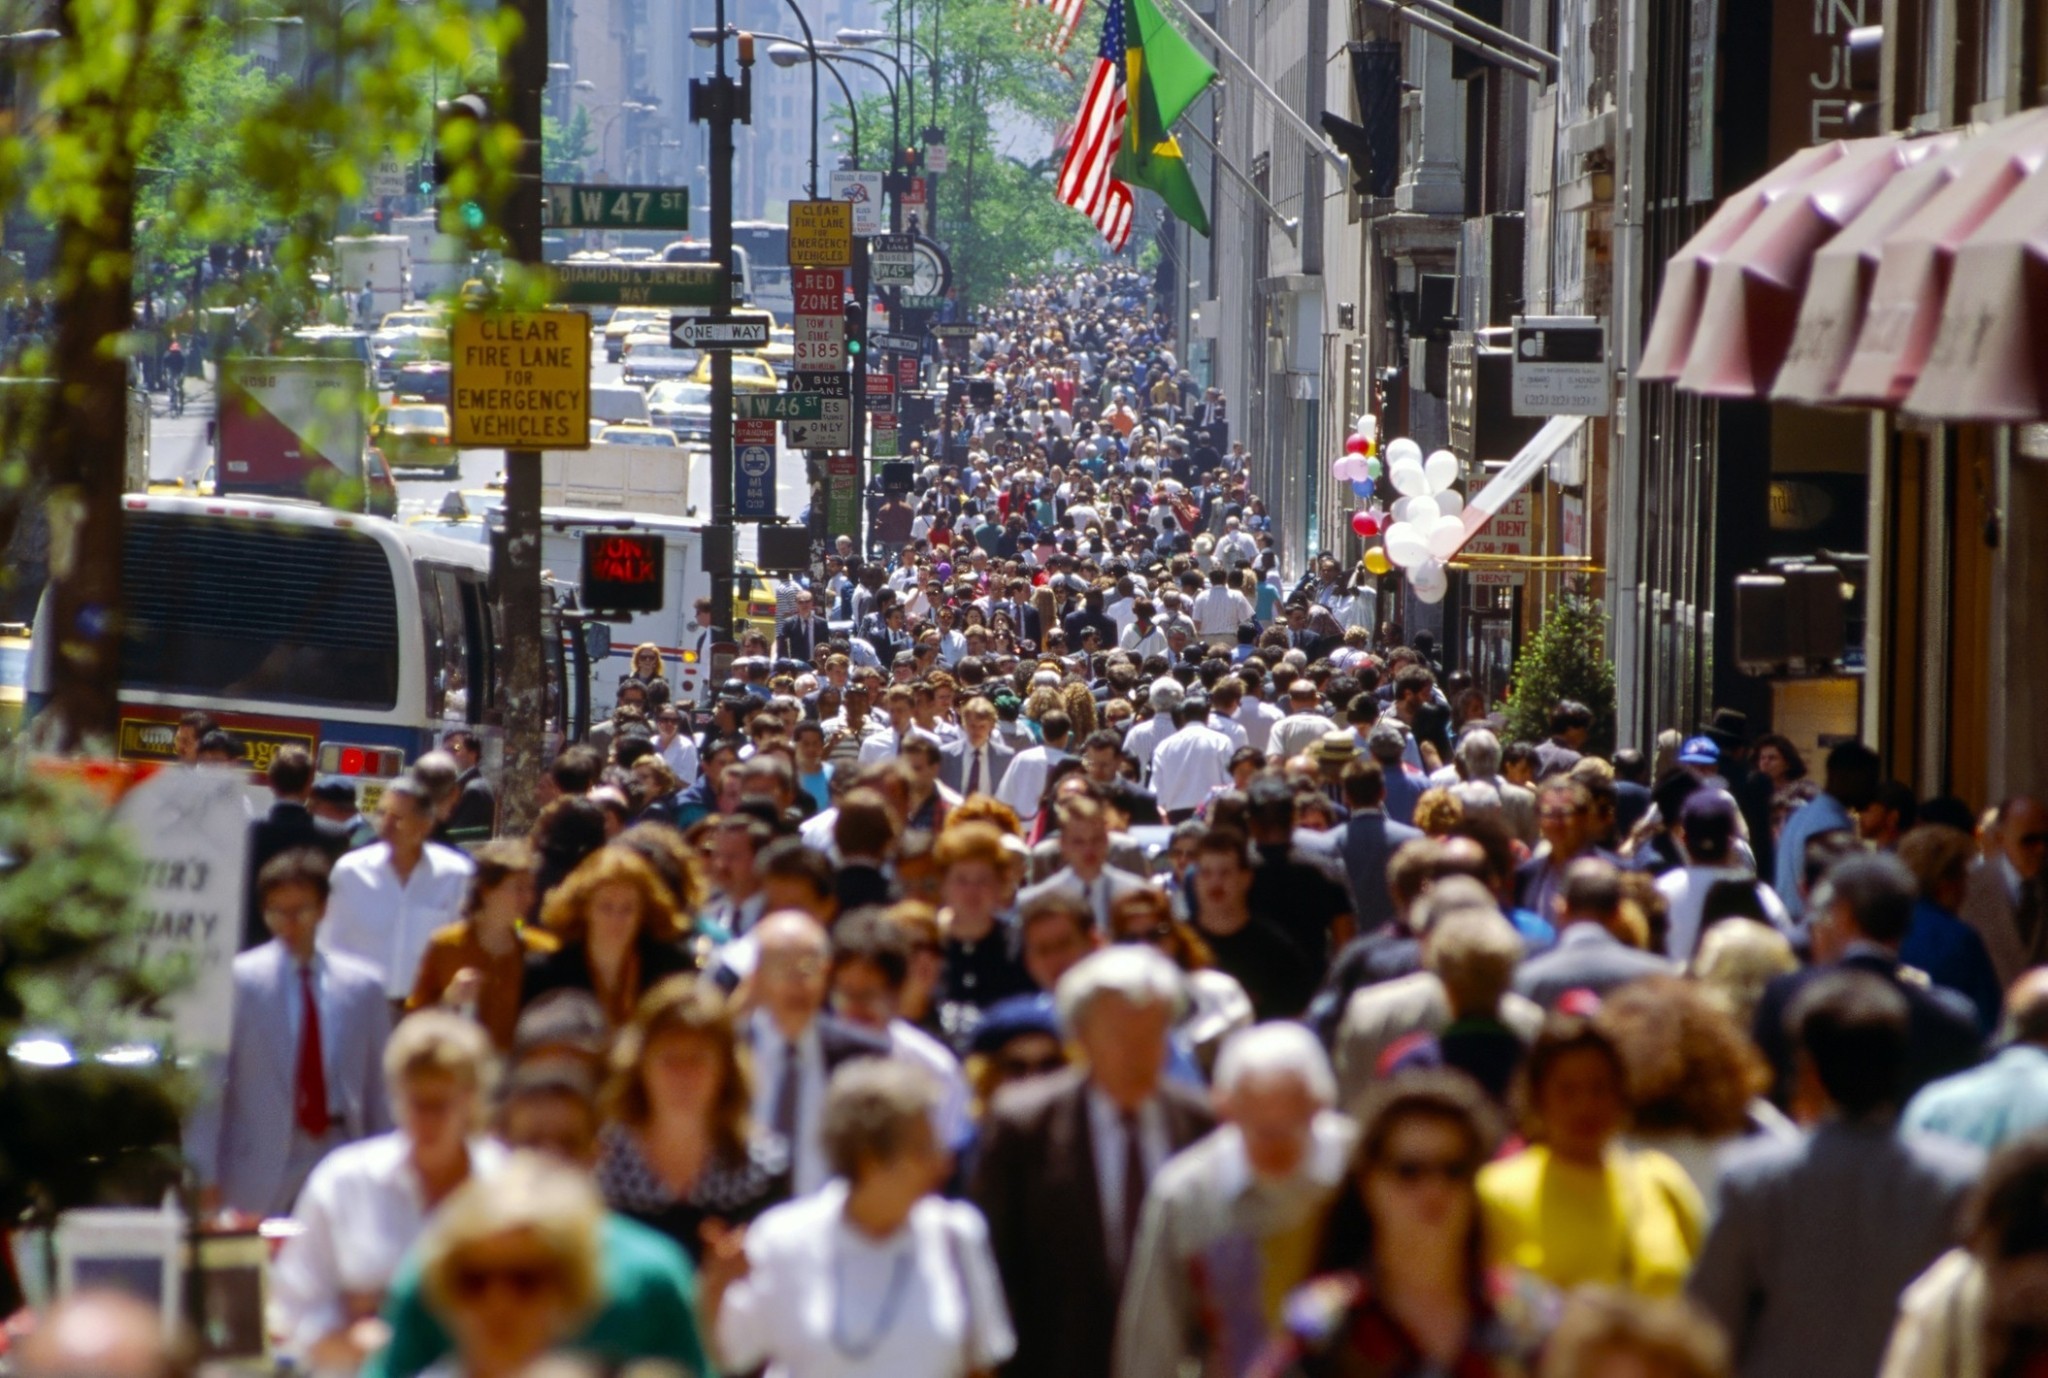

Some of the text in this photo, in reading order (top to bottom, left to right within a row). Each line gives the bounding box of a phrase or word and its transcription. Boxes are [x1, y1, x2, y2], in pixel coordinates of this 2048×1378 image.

[580, 191, 682, 223] W 47 ST
[803, 204, 839, 216] CLEAR
[795, 217, 816, 228] FIRE
[821, 218, 845, 229] LANE
[791, 238, 848, 249] EMERGENCY
[797, 250, 843, 261] VEHICLES
[560, 267, 629, 283] DIAMOND
[646, 269, 714, 285] JEWELRY
[880, 265, 905, 277] W 45
[805, 274, 835, 290] RED
[619, 287, 651, 302] WAY
[800, 295, 838, 310] ZONE
[480, 320, 559, 342] CLEAR
[806, 319, 825, 329] TOW
[685, 326, 761, 339] ONE WAY
[808, 331, 829, 341] FINE
[466, 347, 573, 368] FIRE LANE
[798, 343, 839, 358] $185
[505, 370, 533, 386] FOR
[814, 376, 840, 385] BUS
[458, 389, 581, 411] EMERGENCY
[756, 396, 818, 416] W 46 ST
[469, 415, 571, 437] VEHICLES
[737, 429, 774, 437] STANDING
[811, 423, 843, 433] ONLY
[749, 478, 761, 487] M1
[1496, 521, 1528, 537] RENT
[592, 559, 657, 582] WALK
[1476, 573, 1512, 584] RENT
